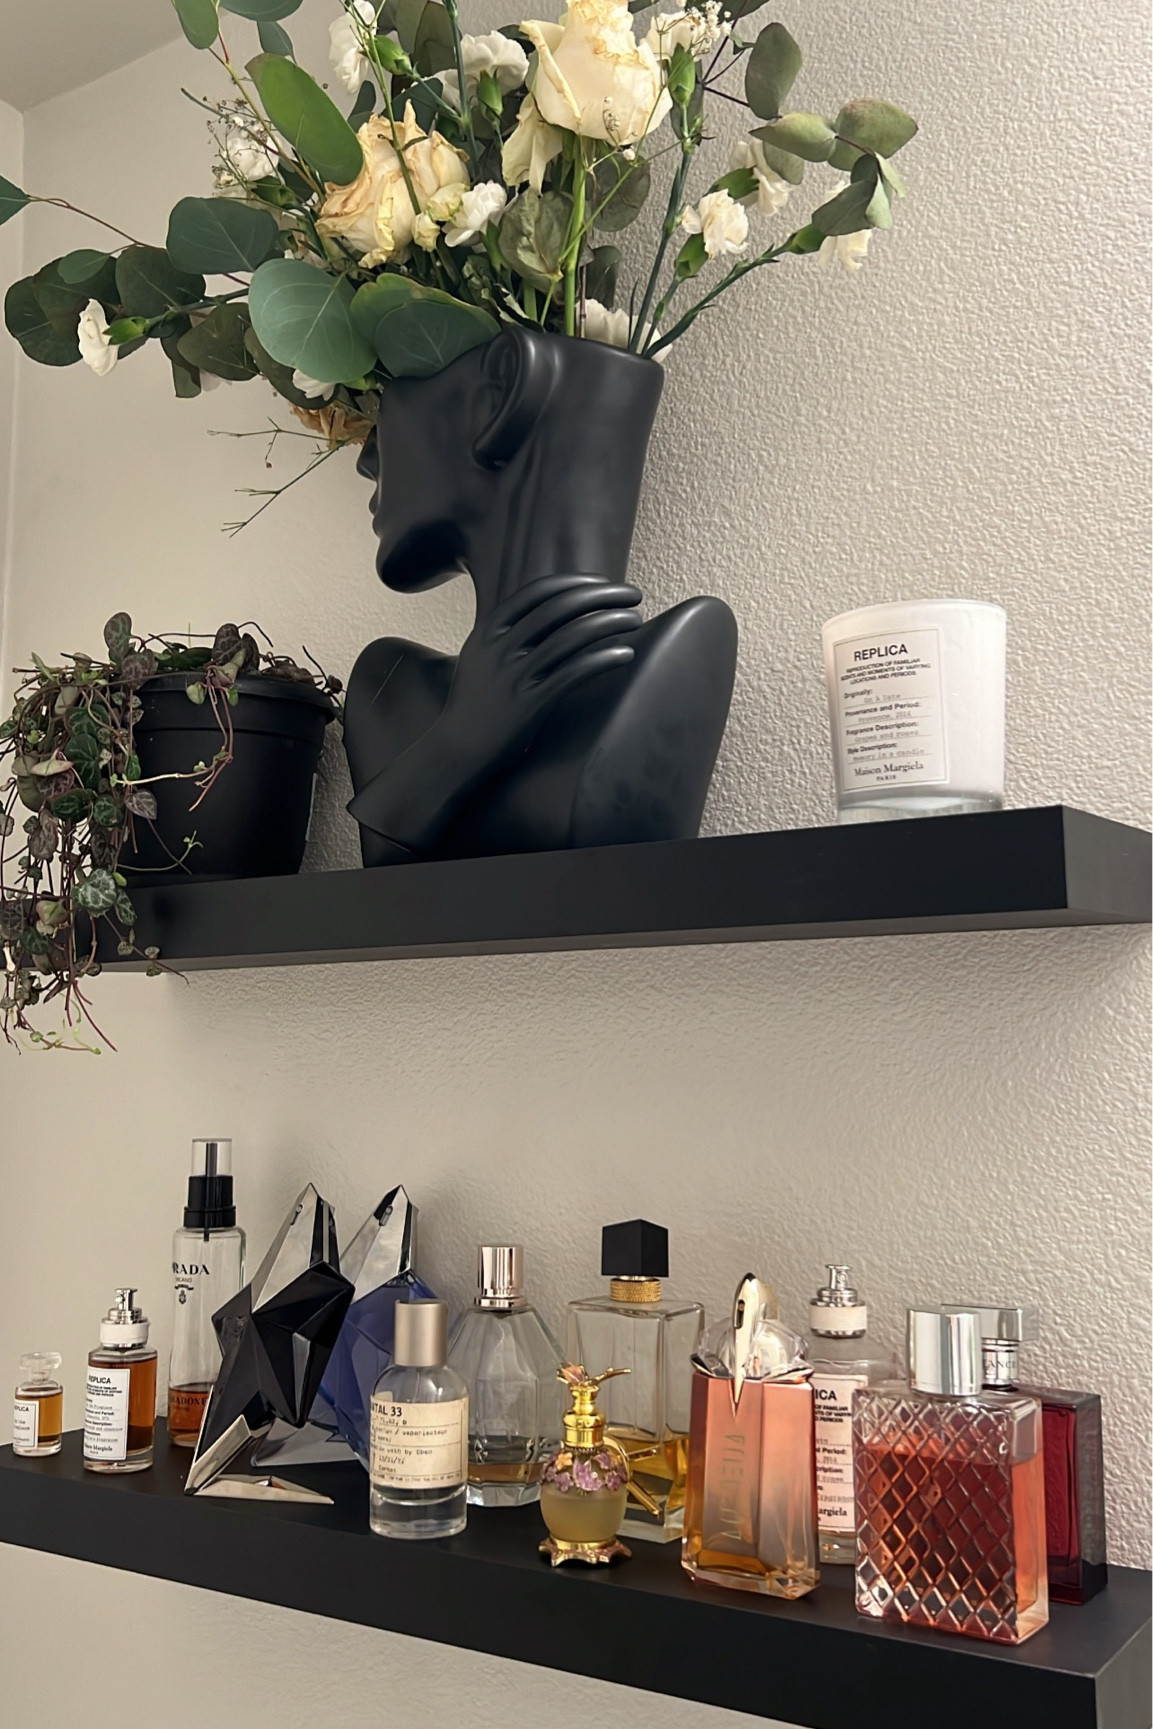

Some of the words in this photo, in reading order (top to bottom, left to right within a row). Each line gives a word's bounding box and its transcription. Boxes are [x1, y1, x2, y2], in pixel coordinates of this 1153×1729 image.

[854, 643, 908, 661] REPLICA
[880, 704, 893, 712] and
[875, 722, 918, 732] Description:
[884, 760, 924, 773] Margiela
[172, 1261, 210, 1275] RADA
[391, 1406, 402, 1417] 33
[818, 1507, 847, 1517] argiela
